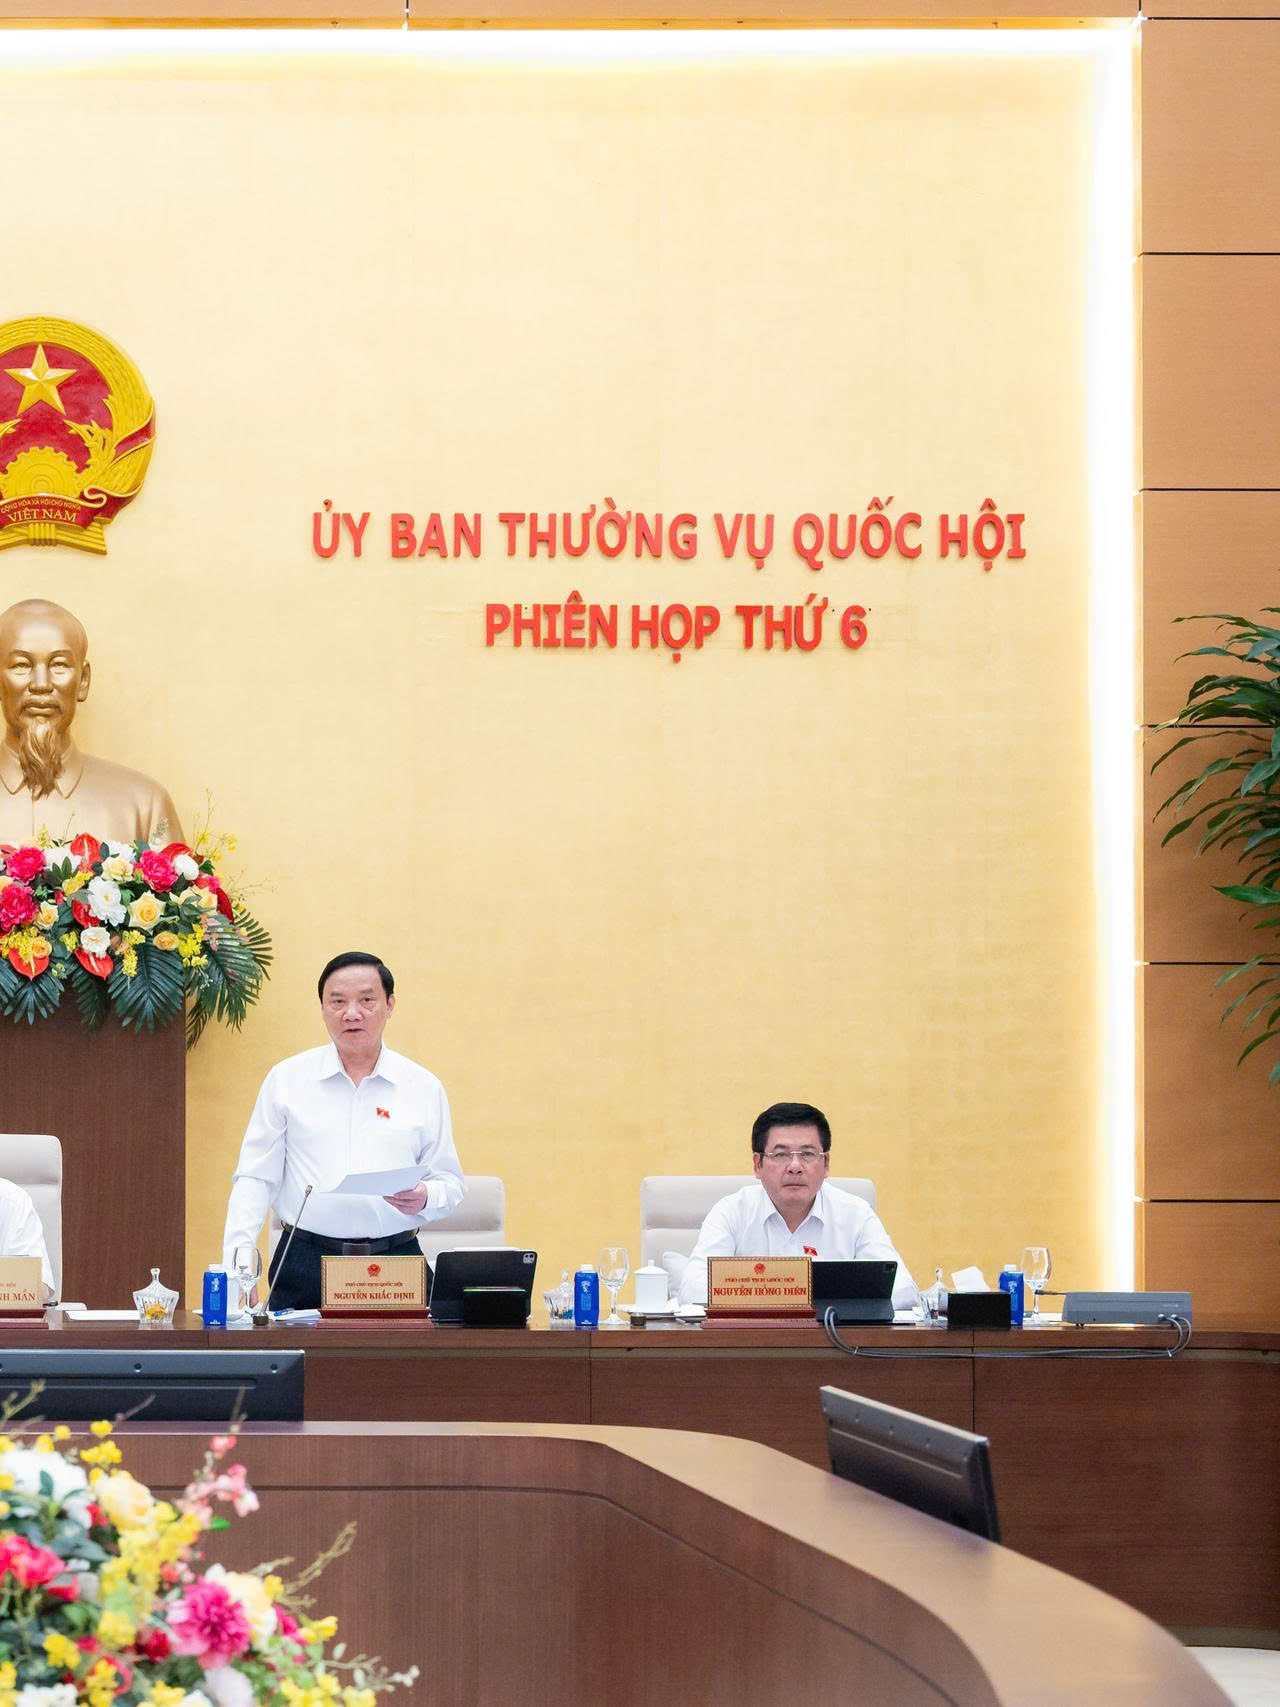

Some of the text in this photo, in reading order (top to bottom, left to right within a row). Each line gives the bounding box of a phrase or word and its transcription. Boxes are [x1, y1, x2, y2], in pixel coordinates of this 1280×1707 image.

[42, 508, 77, 523] NAM
[312, 496, 1027, 571] ỦY BAN THƯỜNG VỤ QUỐC HỘI
[485, 590, 868, 665] PHIÊN HỌP THỨ 6
